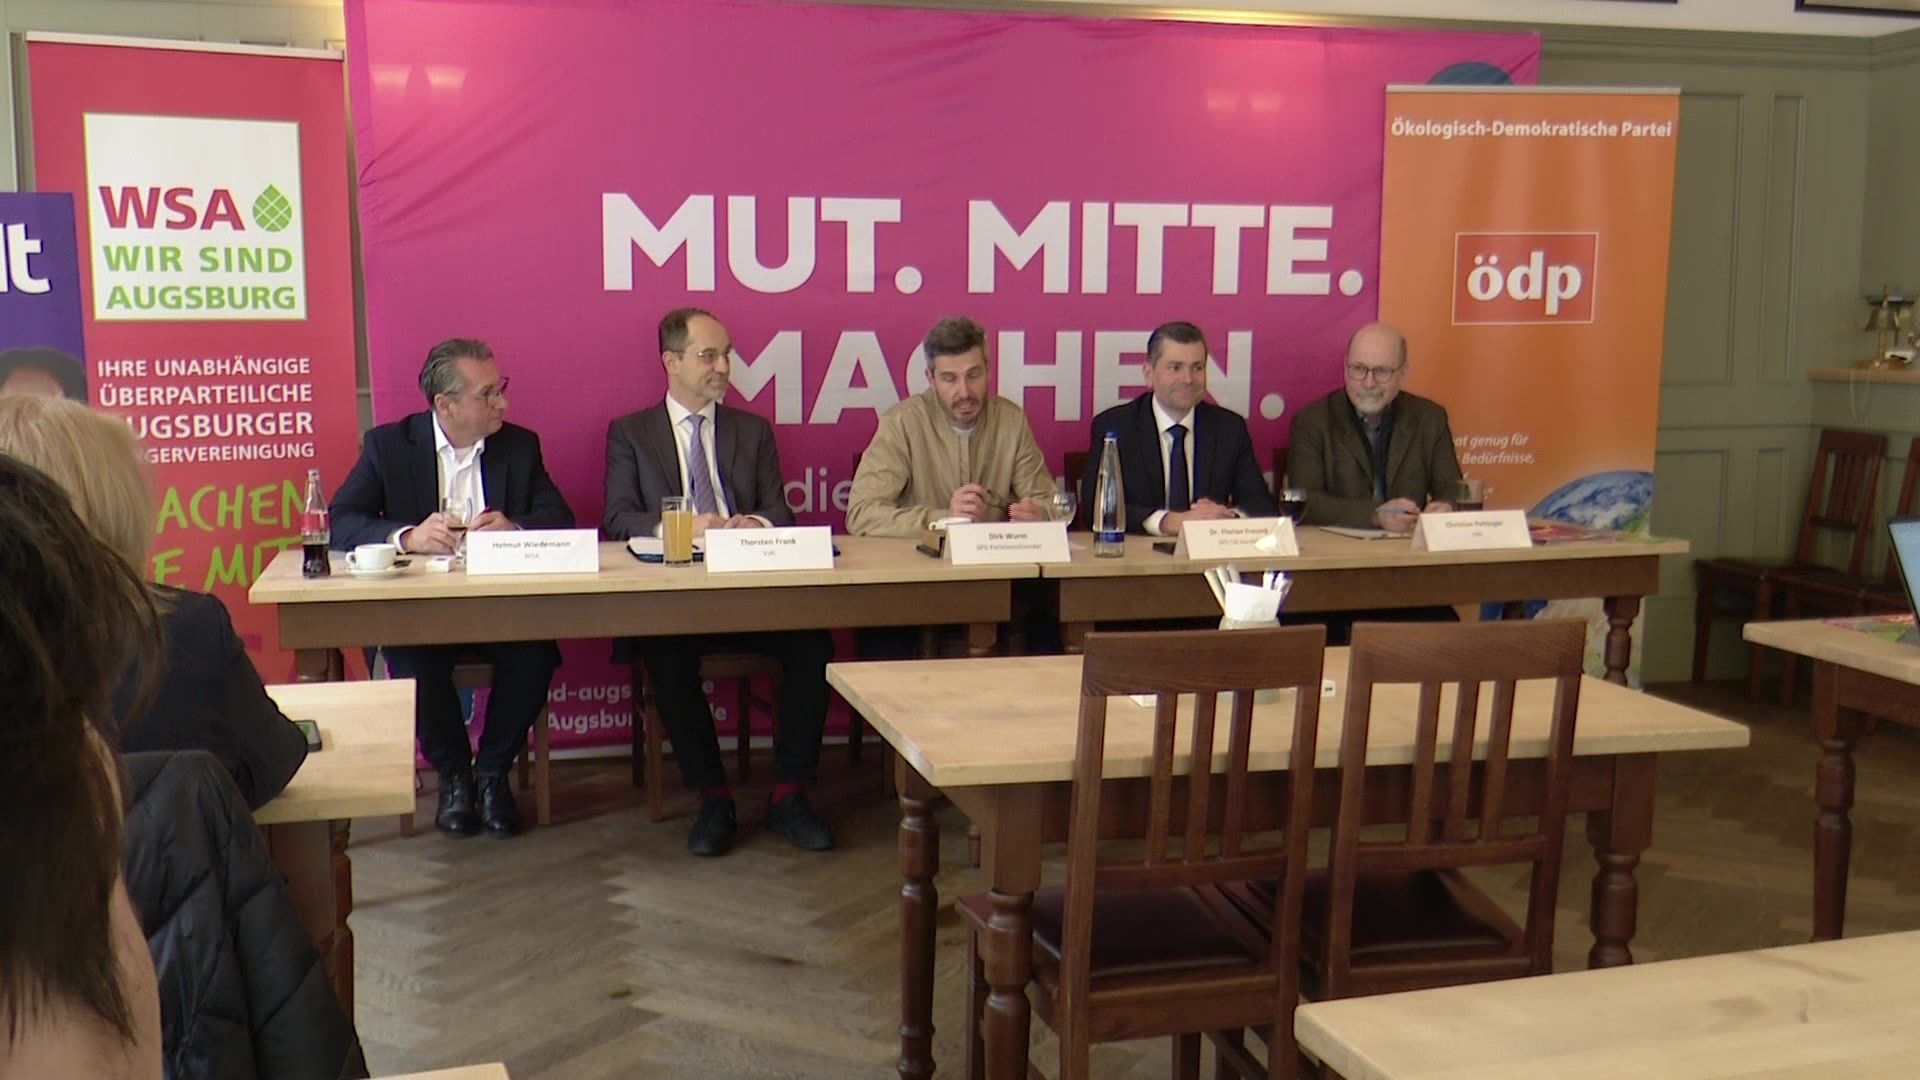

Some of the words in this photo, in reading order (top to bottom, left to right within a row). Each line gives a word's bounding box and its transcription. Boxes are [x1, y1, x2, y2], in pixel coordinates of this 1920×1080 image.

[1391, 118, 1617, 139] Ökologisch-Demokratische
[1621, 121, 1672, 137] Partei
[98, 186, 245, 231] WSA
[602, 193, 923, 294] MUT.
[967, 200, 1363, 296] MITTE.
[103, 246, 182, 272] WIR
[199, 247, 292, 273] SIND
[1467, 250, 1581, 315] ödp
[106, 286, 296, 310] AUGSBURG
[98, 360, 147, 377] IHRE
[155, 356, 310, 376] UNABHÄNGIGE
[99, 382, 312, 408] ÜBERPARTEILICHE
[127, 411, 314, 441] UGSBURGER
[145, 443, 315, 464] GERVEREINIGUNG
[1469, 434, 1509, 449] genug
[1510, 432, 1529, 446] für
[156, 480, 303, 534] ACHEN
[775, 537, 797, 547] Frank
